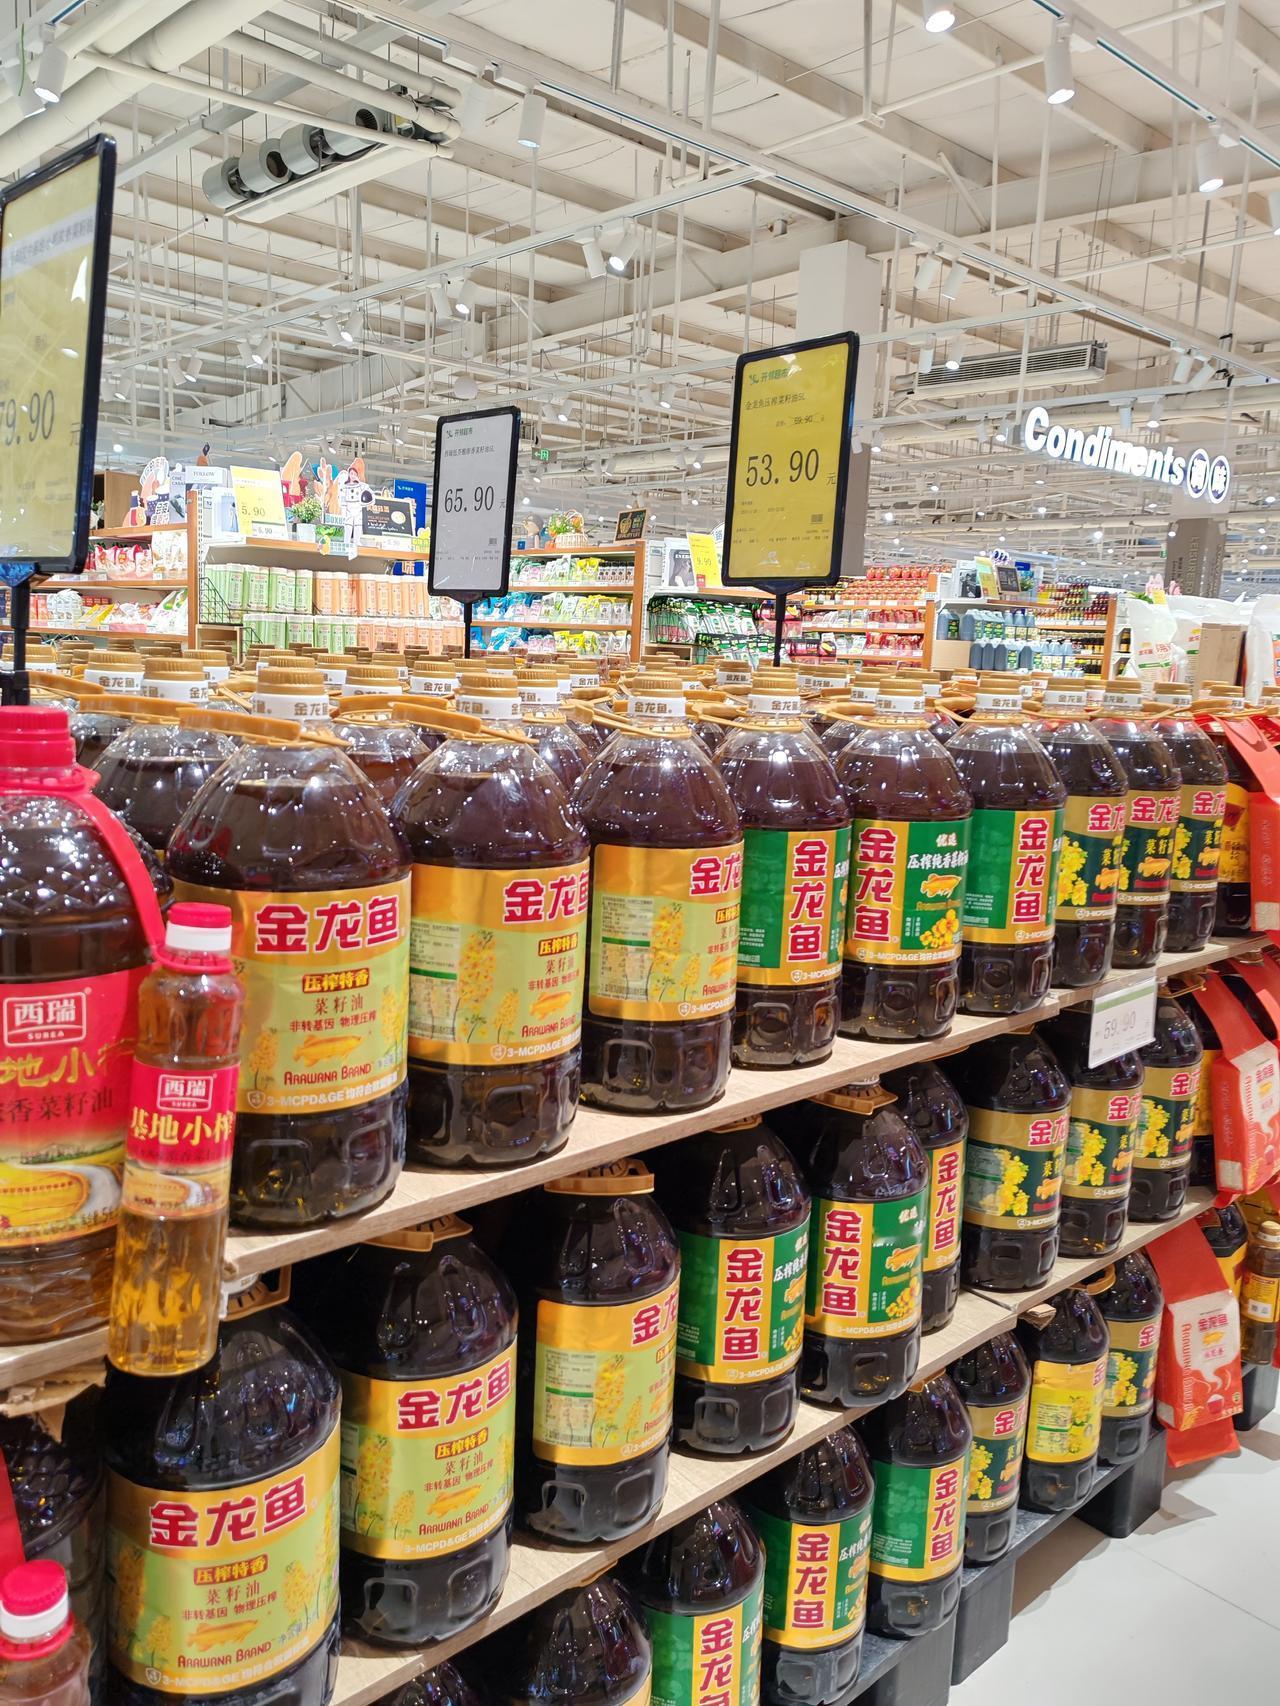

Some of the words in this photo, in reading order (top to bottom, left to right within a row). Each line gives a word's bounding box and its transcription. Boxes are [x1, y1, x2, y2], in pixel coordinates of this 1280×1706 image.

[0, 389, 55, 446] 9.90
[1024, 406, 1187, 486] Condiments
[745, 447, 820, 488] 53.90
[444, 485, 495, 513] 65.90
[99, 676, 135, 688] 金龙鱼
[635, 701, 668, 714] 金龙鱼
[853, 826, 899, 944] 金龙鱼
[1011, 817, 1050, 924] 金龙鱼
[786, 838, 829, 963] 金龙鱼
[255, 894, 400, 955] 金龙鱼
[303, 968, 370, 993] 压榨特香
[14, 998, 77, 1027] 西瑞
[314, 993, 365, 1017] 菜籽油
[289, 1017, 335, 1034] 非转基因
[340, 1009, 378, 1029] 物理压榨
[165, 1080, 207, 1098] 西瑞
[284, 1069, 338, 1087] ARAWANA
[341, 1062, 373, 1079] BRAND
[934, 1151, 960, 1251] 金龙鱼
[821, 1208, 864, 1318] 金龙鱼
[722, 1246, 765, 1363] 金龙鱼
[1198, 1313, 1229, 1332] 金龙鱼
[397, 1357, 512, 1431] 金龙鱼
[435, 1427, 489, 1458] 压榨特香
[444, 1450, 484, 1477] 菜籽油
[423, 1475, 461, 1493] 非转基因
[150, 1474, 306, 1549] 金龙鱼
[418, 1518, 463, 1536] ARAWANA
[465, 1502, 490, 1523] BRAND
[930, 1468, 960, 1562] 金龙鱼
[195, 1555, 268, 1585] 压榨特香
[791, 1532, 831, 1629] 金龙鱼
[182, 1606, 229, 1621] 非转基因
[233, 1591, 278, 1613] 物理压榨
[206, 1579, 261, 1605] 菜籽油
[177, 1653, 232, 1669] ARAWANA
[235, 1640, 273, 1663] BRAND
